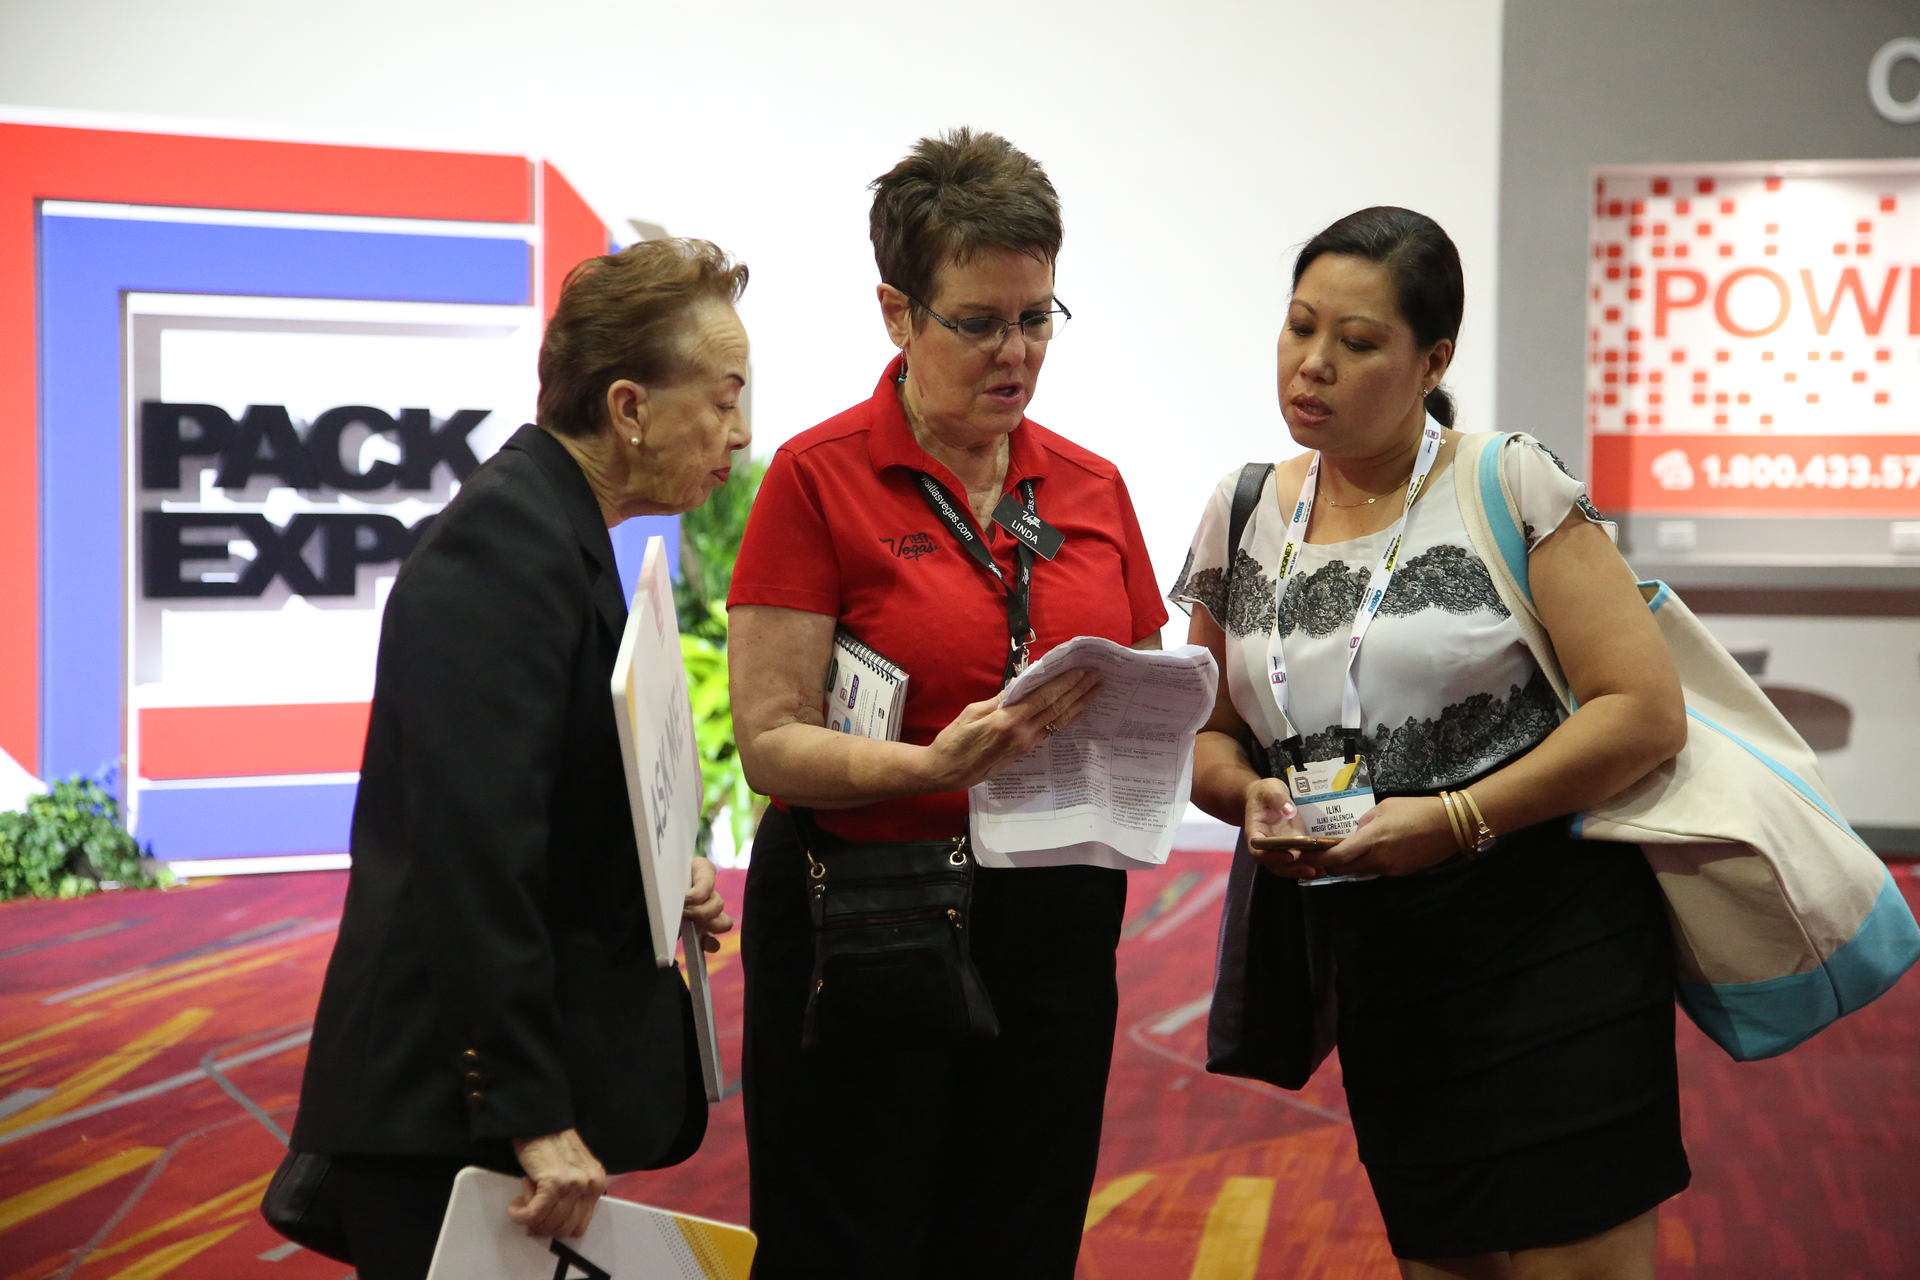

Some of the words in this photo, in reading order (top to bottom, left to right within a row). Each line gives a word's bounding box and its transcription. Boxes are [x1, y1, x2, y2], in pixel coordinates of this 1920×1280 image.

[1654, 267, 1920, 339] POW
[142, 401, 492, 492] PACK
[921, 474, 974, 542] visitlasvegas.com
[1293, 500, 1304, 523] ORBIS
[1010, 520, 1038, 545] LINDA
[879, 535, 942, 562] Vegas
[1280, 541, 1294, 580] COGNEX
[1368, 589, 1382, 614] ORBIS
[650, 734, 674, 857] ASK
[1326, 805, 1341, 814] ILIKI
[1329, 813, 1354, 822] VALENCIA
[1327, 821, 1351, 830] CREATIVE
